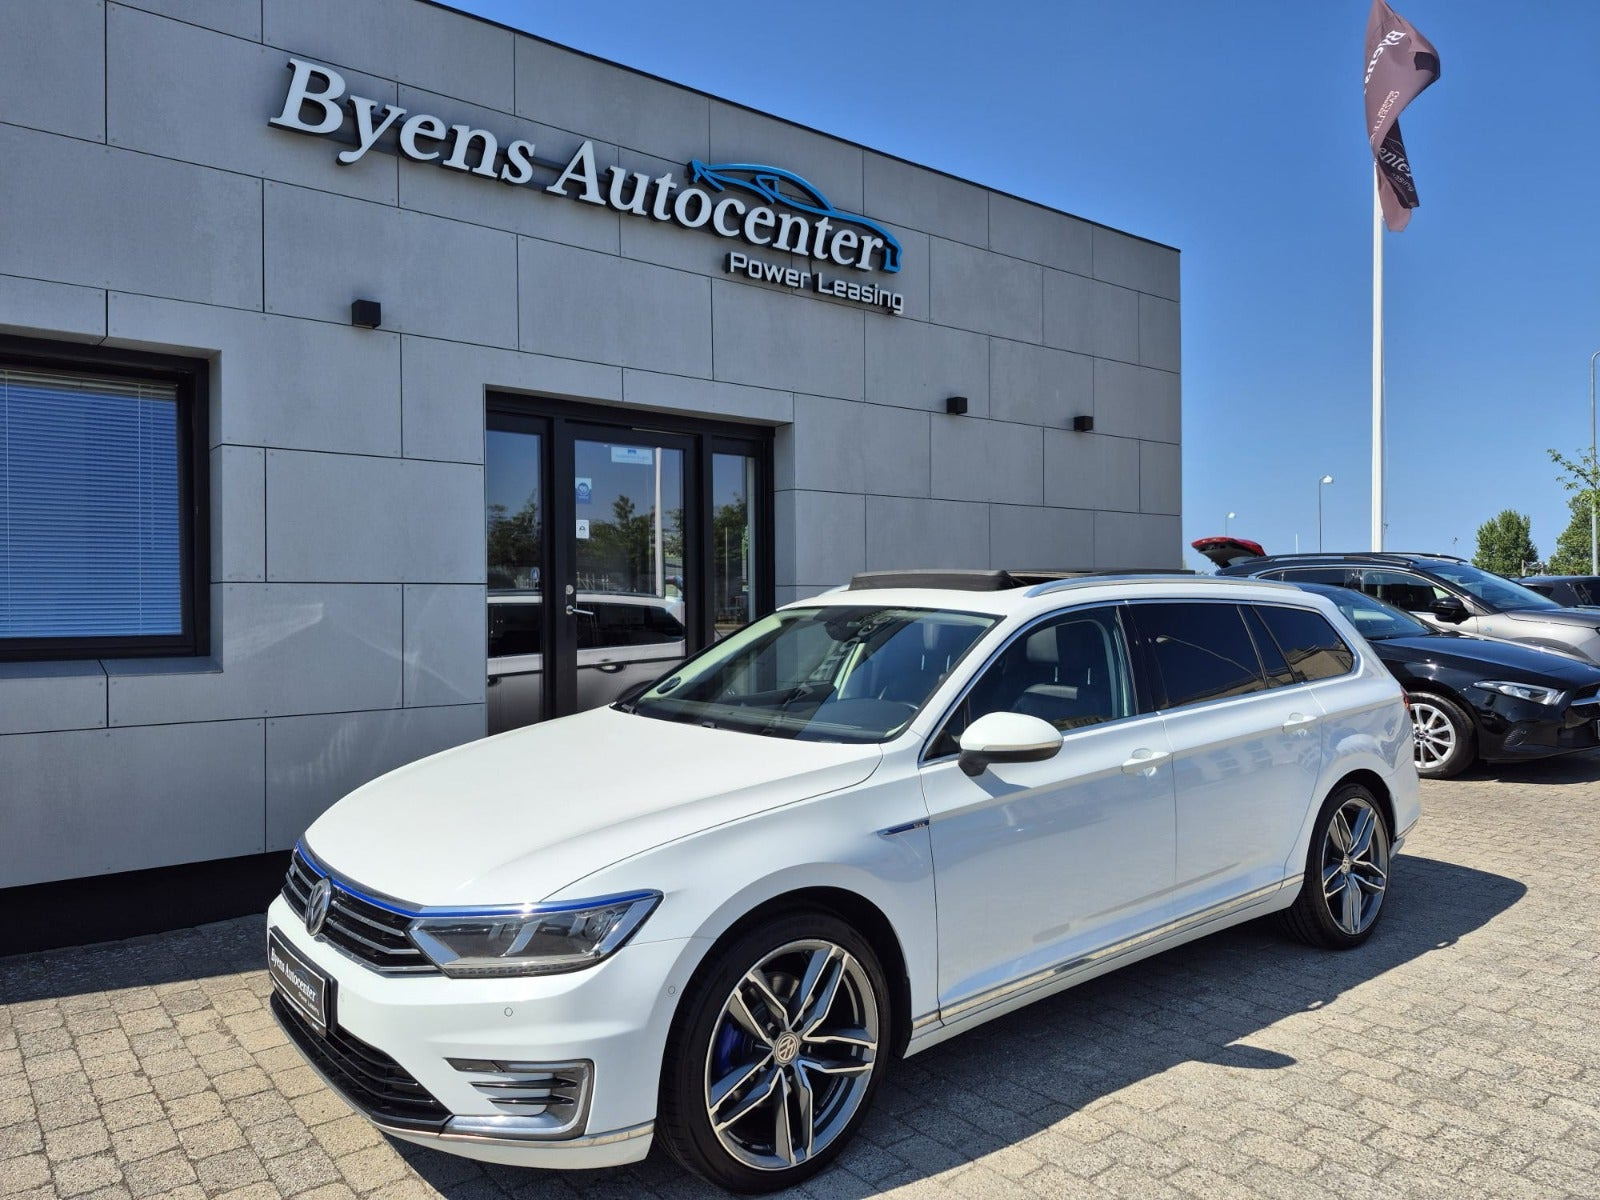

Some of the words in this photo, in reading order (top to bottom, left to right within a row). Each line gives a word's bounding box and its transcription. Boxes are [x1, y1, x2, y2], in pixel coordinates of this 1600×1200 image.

[269, 58, 535, 184] Byens
[546, 141, 884, 272] Autocenter
[729, 251, 811, 289] Power
[817, 272, 905, 315] Leasing
